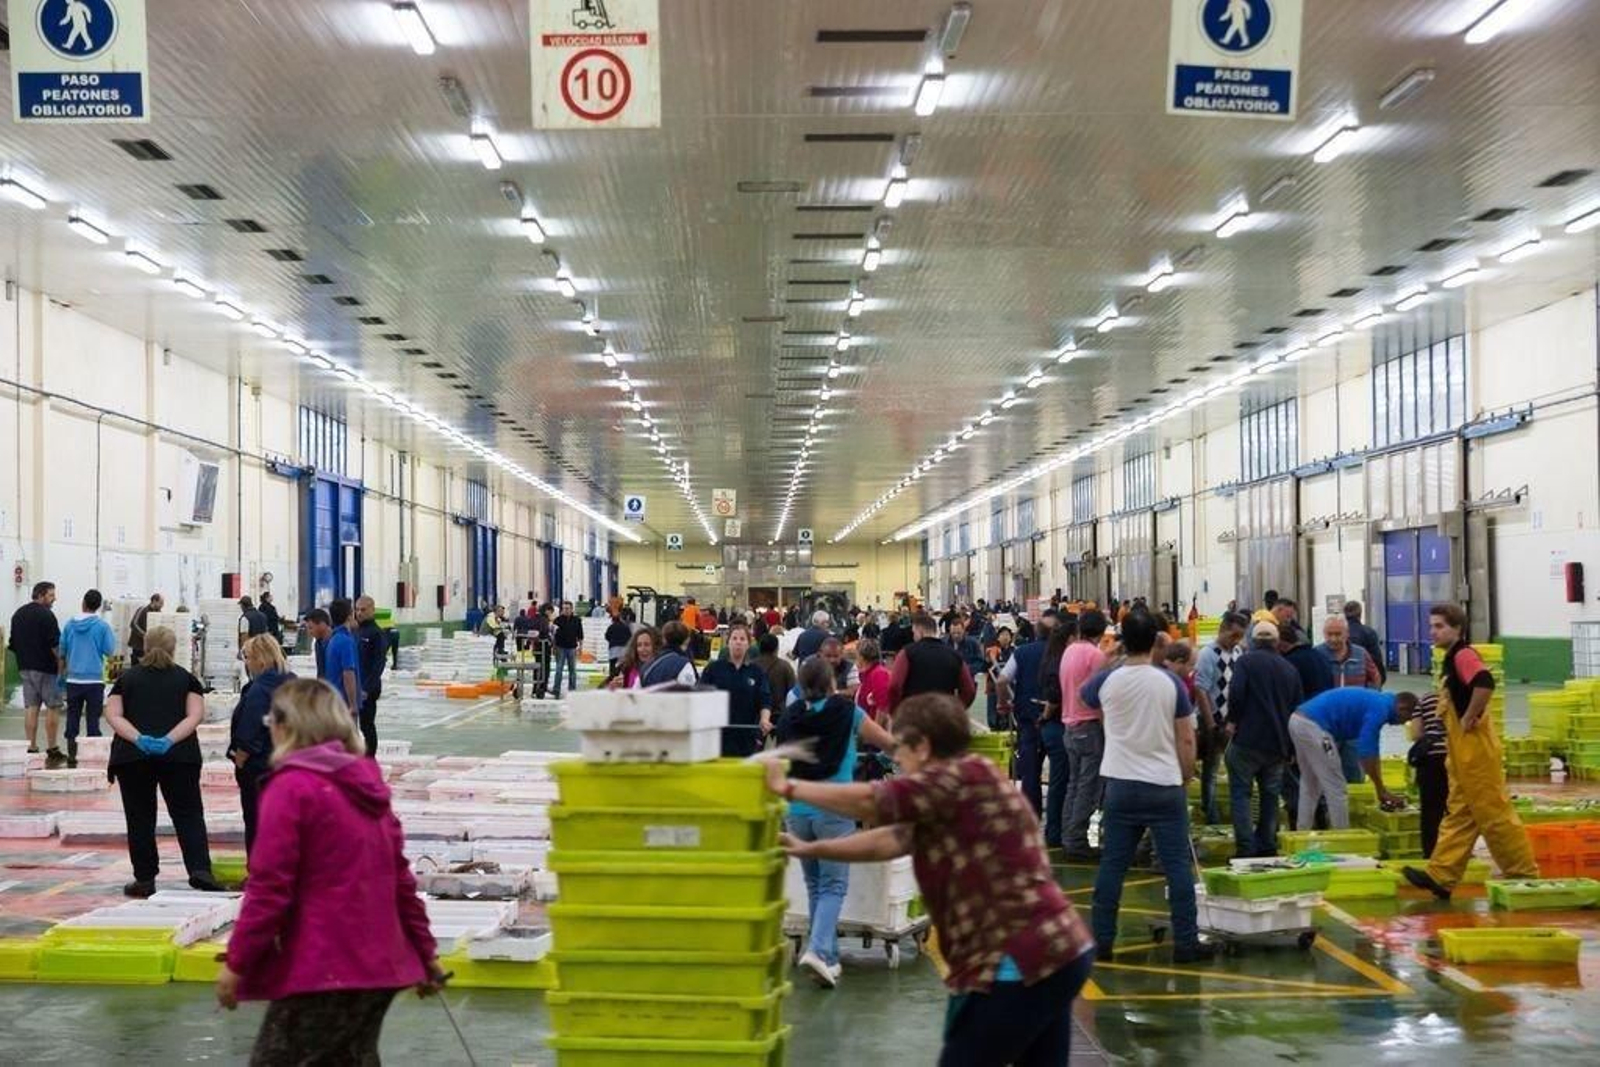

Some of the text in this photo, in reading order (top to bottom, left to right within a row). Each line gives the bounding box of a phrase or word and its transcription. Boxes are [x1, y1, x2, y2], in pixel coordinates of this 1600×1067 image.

[549, 35, 602, 47] VELOCIDAD
[61, 75, 99, 85] PASO
[1215, 69, 1252, 81] PASO
[575, 68, 617, 101] 10
[1195, 82, 1269, 97] PEATONES
[42, 89, 119, 101] PEATONES
[31, 104, 132, 116] OBLIGATORIO
[1184, 96, 1279, 112] OBLIGATORIO
